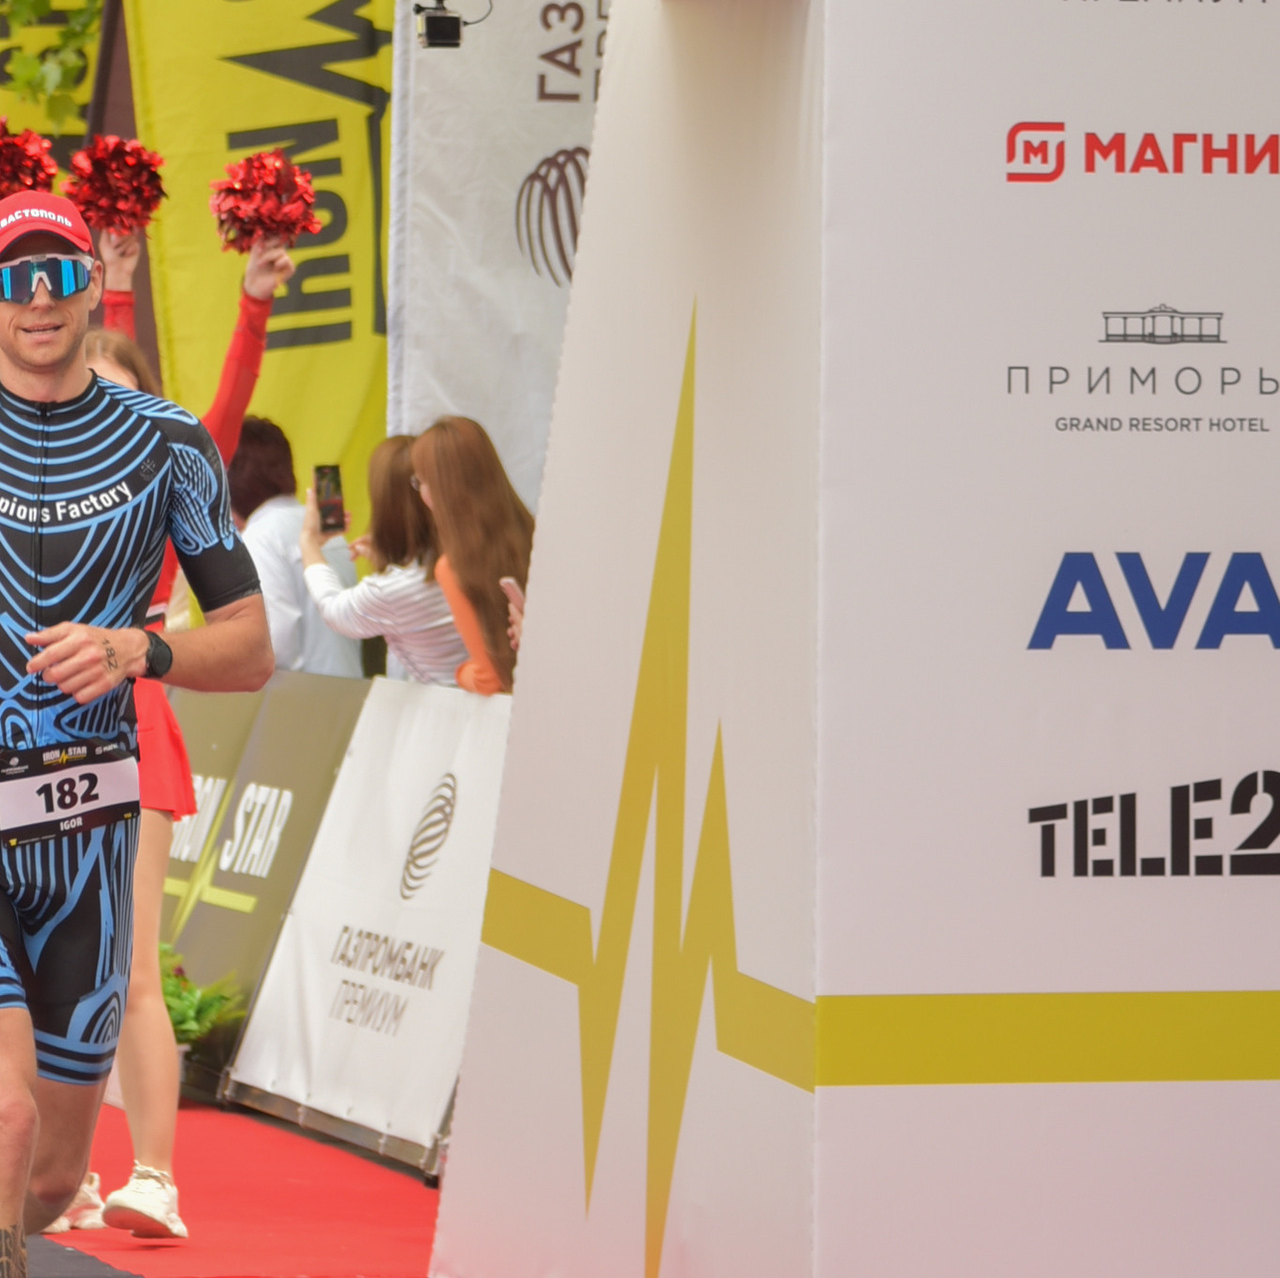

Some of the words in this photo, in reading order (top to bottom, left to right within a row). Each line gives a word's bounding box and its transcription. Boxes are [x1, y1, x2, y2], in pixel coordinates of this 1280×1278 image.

[1055, 417, 1122, 432] GRAND
[1129, 417, 1202, 432] RESORT
[1209, 417, 1270, 433] HOTEL
[55, 480, 134, 522] Factory
[1026, 551, 1280, 650] AVA
[35, 772, 100, 814] 182
[59, 816, 83, 832] IGOR
[219, 782, 294, 879] STAR
[1028, 768, 1280, 878] TELE2
